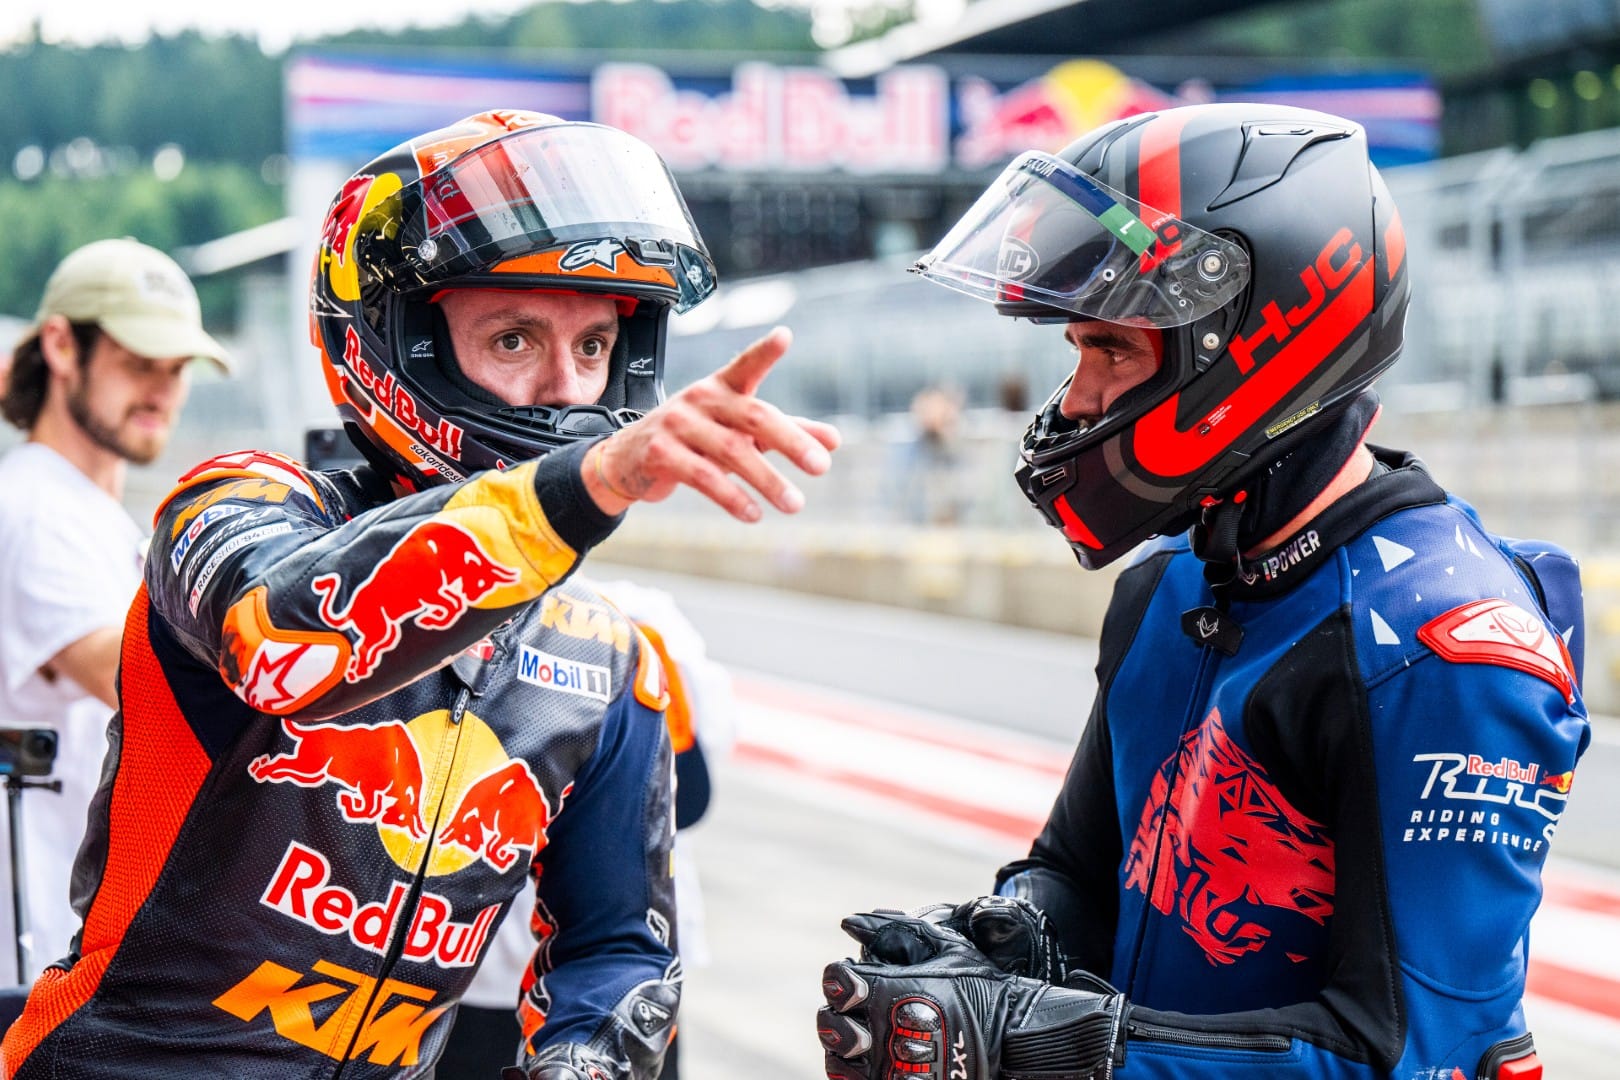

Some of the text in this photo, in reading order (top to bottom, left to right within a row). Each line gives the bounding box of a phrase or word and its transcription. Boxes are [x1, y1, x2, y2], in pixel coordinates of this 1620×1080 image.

[1228, 227, 1362, 375] HJC
[343, 324, 464, 461] Red Bull
[173, 507, 241, 566] Mobil
[540, 591, 631, 656] KTM
[521, 650, 582, 690] Mobil
[1467, 754, 1540, 785] Red Bull
[1402, 828, 1543, 852] EXPERIENCE
[1410, 809, 1500, 826] RIDING
[259, 840, 502, 968] Red Bull
[211, 959, 450, 1067] KTM
[950, 1030, 968, 1080] 2XL
